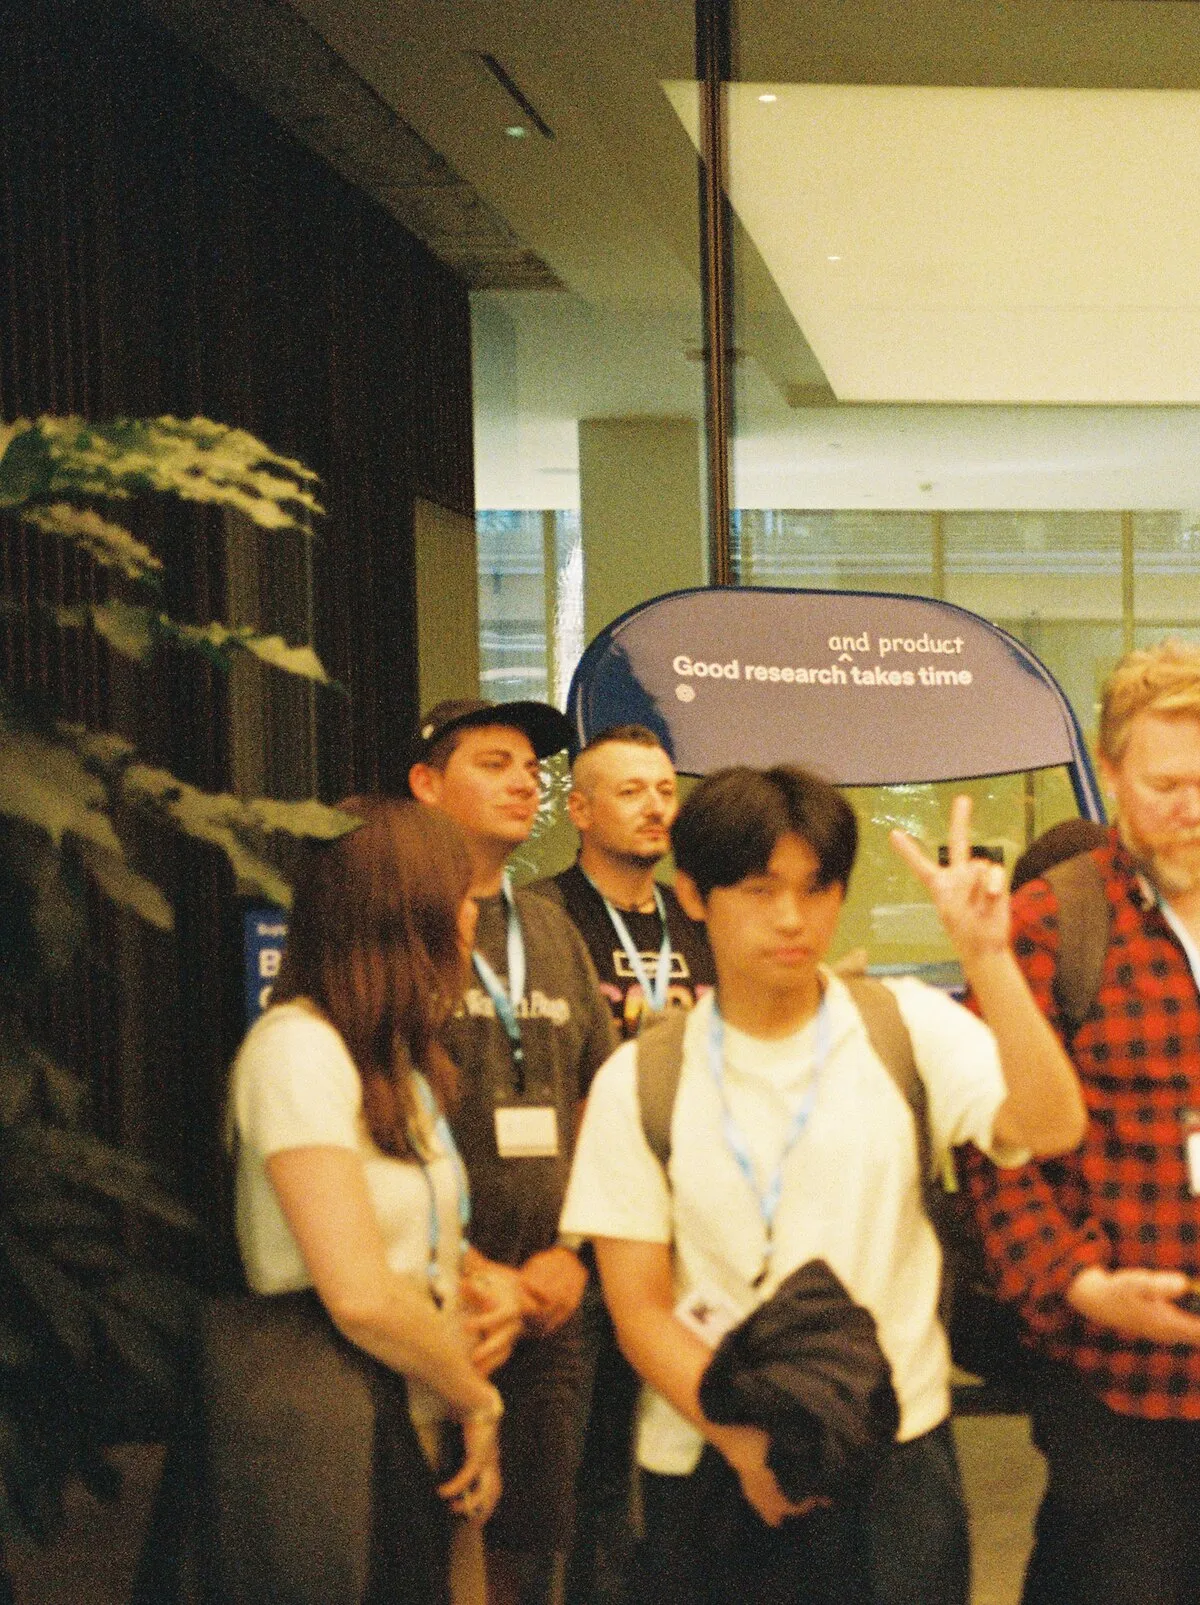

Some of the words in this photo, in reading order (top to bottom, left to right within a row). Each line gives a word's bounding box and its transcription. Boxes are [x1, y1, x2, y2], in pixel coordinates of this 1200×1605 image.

[828, 631, 870, 652] and
[878, 632, 964, 658] product
[672, 655, 739, 679] Good
[744, 664, 847, 684] research
[850, 666, 915, 686] takes
[917, 666, 973, 686] time
